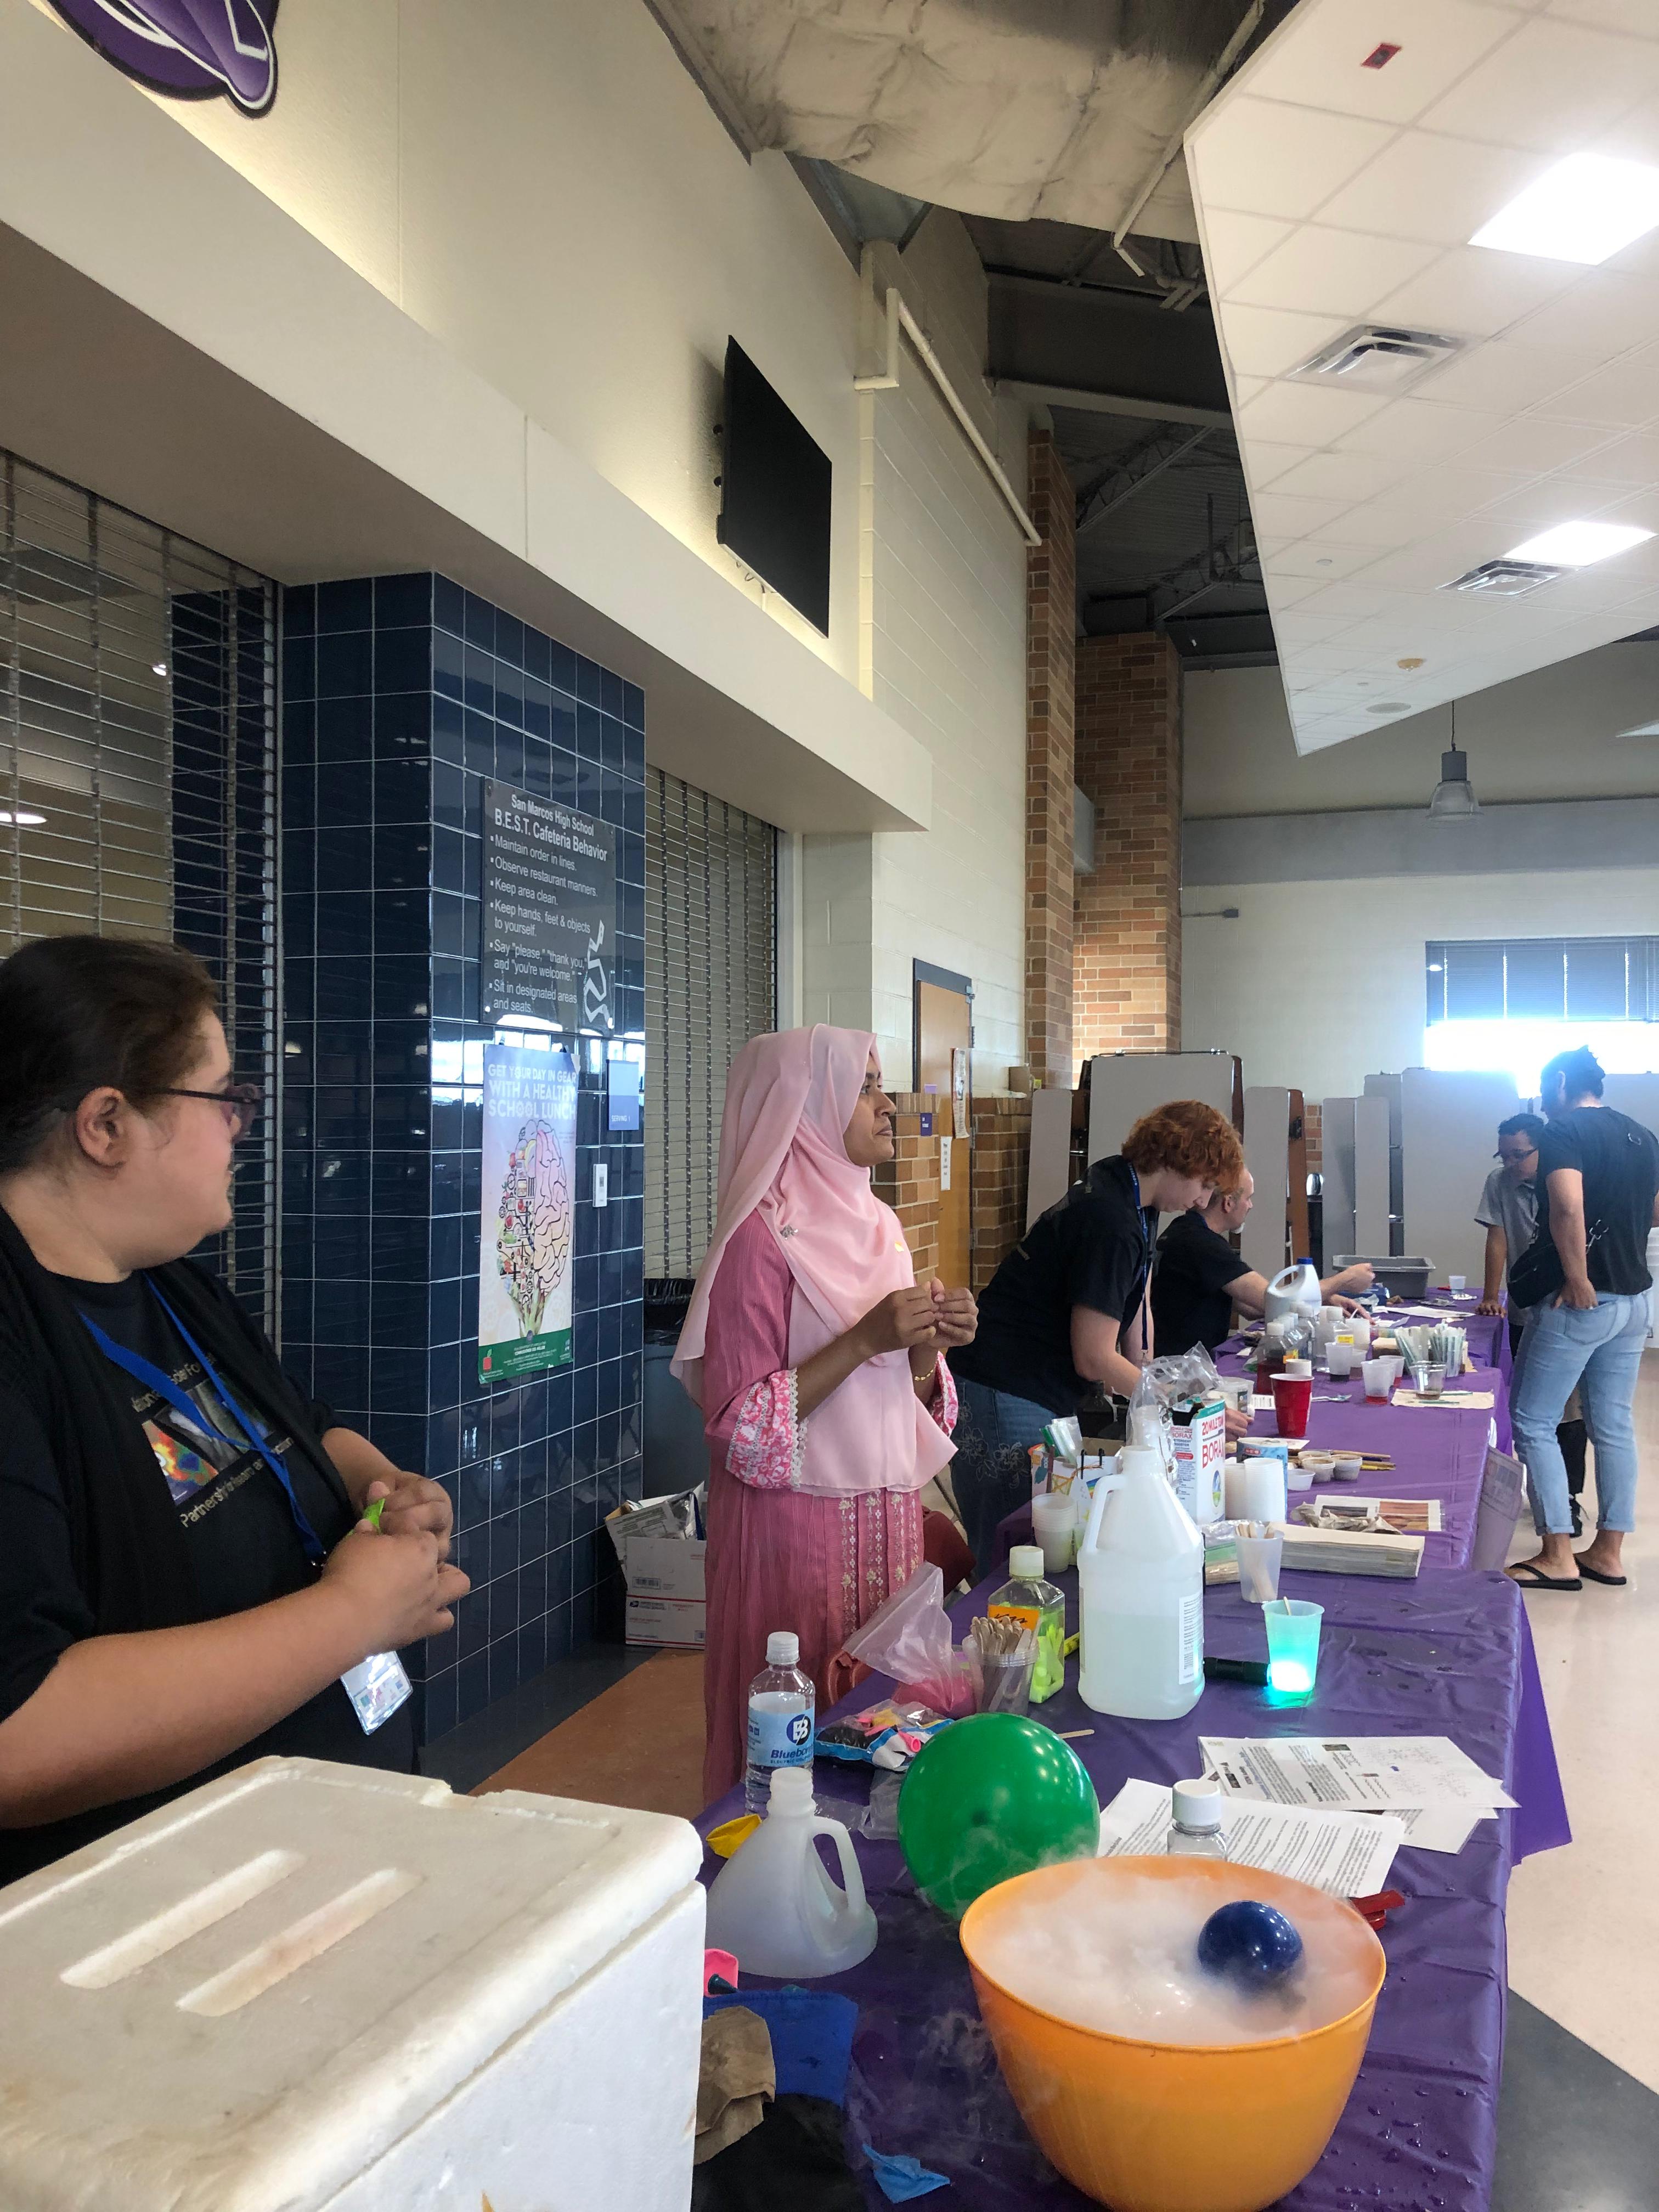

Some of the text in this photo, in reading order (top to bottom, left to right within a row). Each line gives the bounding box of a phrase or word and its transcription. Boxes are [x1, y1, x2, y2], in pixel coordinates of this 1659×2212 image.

[512, 794, 594, 836] San Marcos High School
[495, 808, 607, 861] B.E.S.T. Cafeteria Behavior
[495, 834, 577, 871] Maintain order in lines.
[495, 856, 597, 896] Observe restaurant manners.
[495, 877, 558, 905] Keep area clean.
[495, 899, 590, 934] Keep hands, feet & objects
[495, 916, 537, 936] to yourself.
[494, 939, 510, 956] Say
[547, 950, 569, 965] "thank
[494, 958, 509, 970] and
[494, 979, 577, 1003] Sit in designated areas
[494, 998, 534, 1013] and seats.
[488, 1064, 576, 1084] GET YOUR DAY IN GEAR
[489, 1080, 575, 1102] WITH A HEALTHY
[489, 1099, 576, 1120] SCHOOL LUNCH
